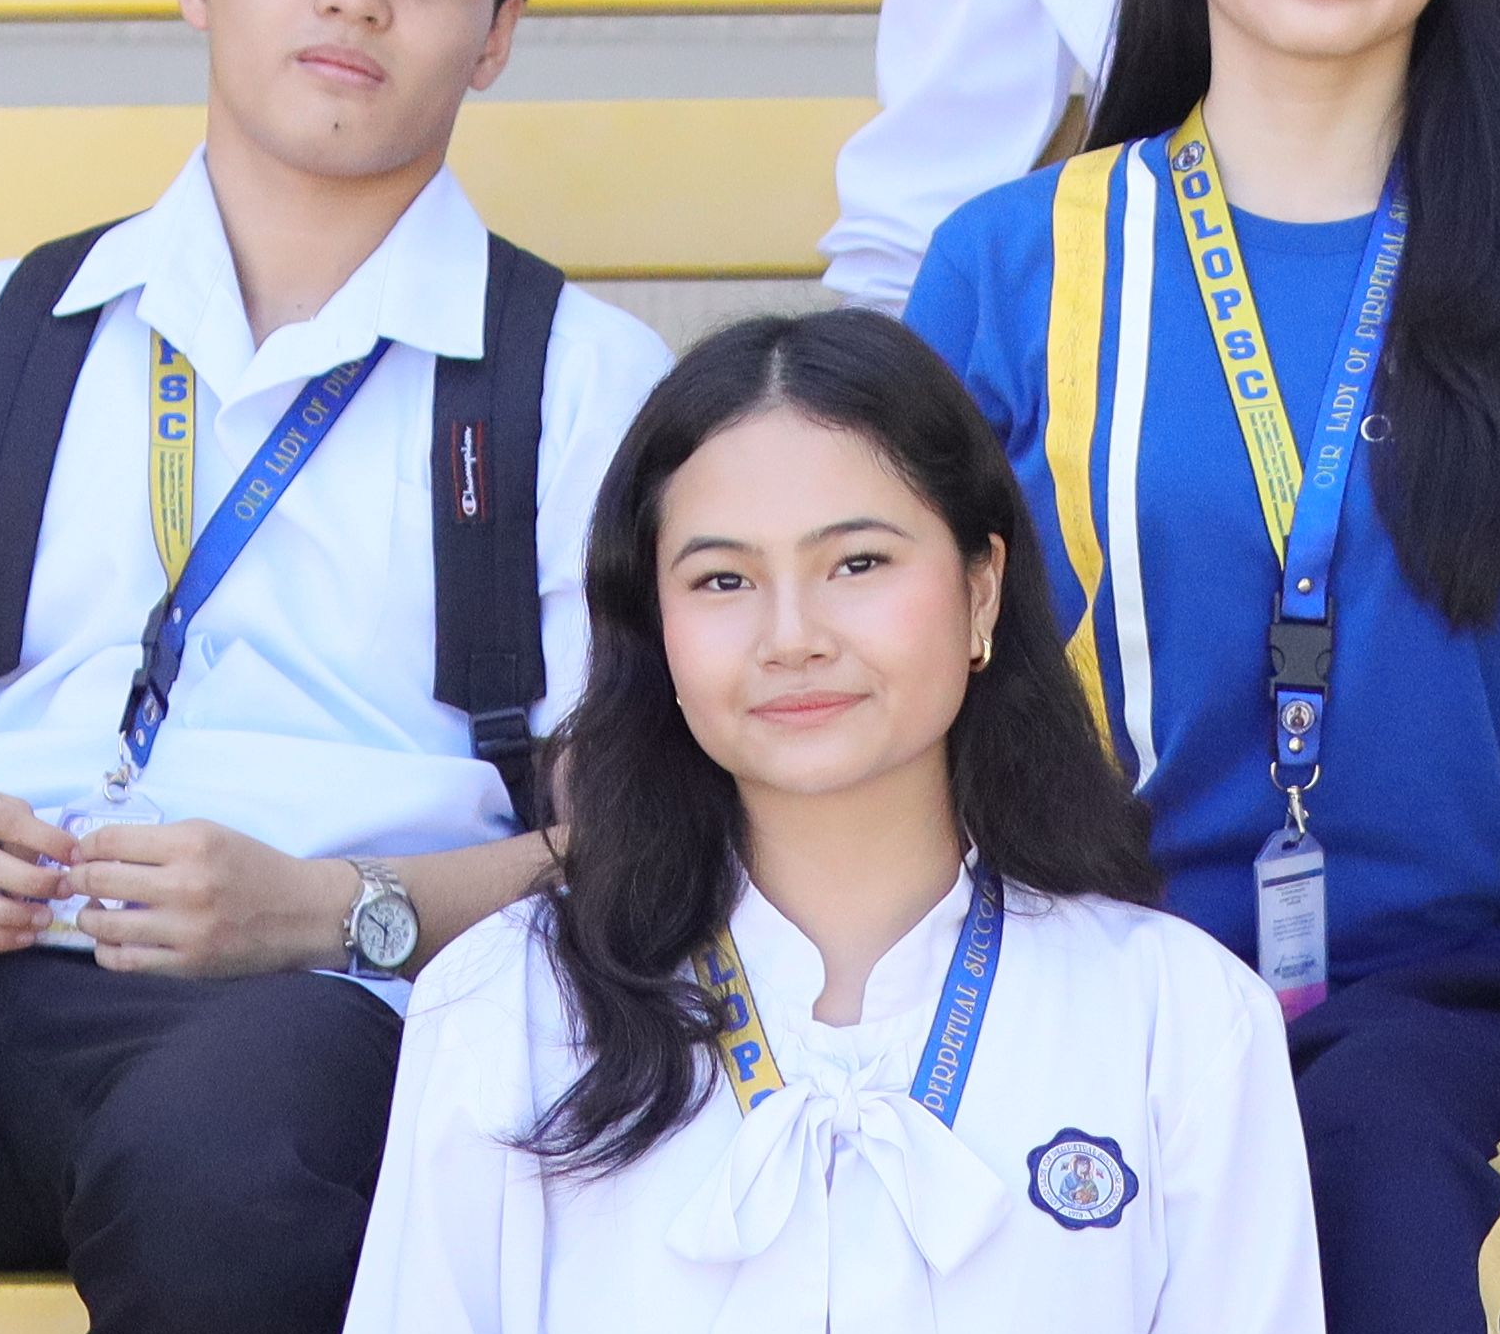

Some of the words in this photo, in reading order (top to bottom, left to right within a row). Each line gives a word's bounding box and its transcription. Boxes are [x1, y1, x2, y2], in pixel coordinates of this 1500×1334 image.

[1181, 169, 1269, 400] OLOPSC
[1355, 231, 1406, 339] PERPETUAL
[1326, 383, 1359, 433] LADY
[1345, 346, 1372, 374] OF
[234, 478, 274, 520] OUR
[264, 427, 309, 475] LADY
[302, 397, 330, 426] OF
[1313, 443, 1343, 489] OUR
[923, 984, 979, 1113] PERPETUAL
